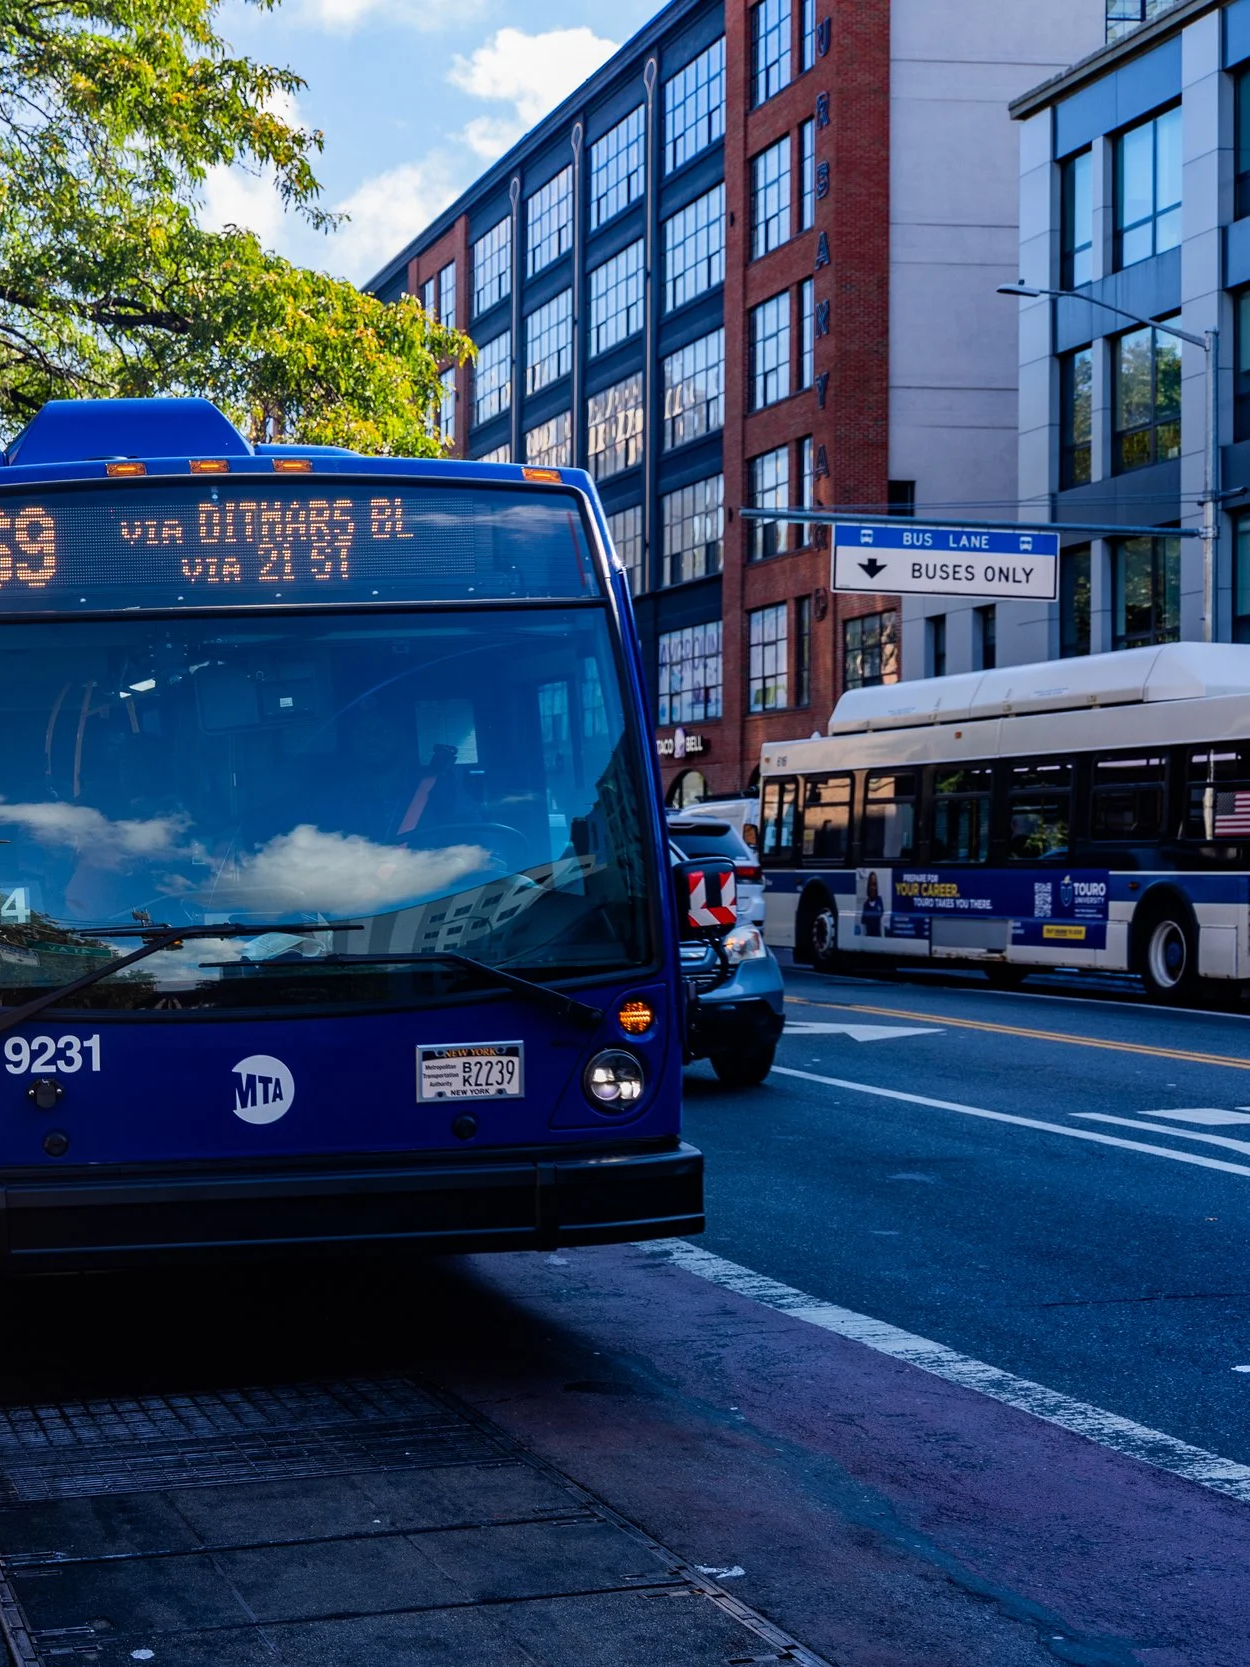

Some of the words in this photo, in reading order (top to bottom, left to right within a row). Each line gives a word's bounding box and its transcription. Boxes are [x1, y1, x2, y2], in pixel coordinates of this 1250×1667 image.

[120, 520, 183, 545] VIA
[199, 500, 354, 543] DITMARS
[370, 498, 414, 538] BL
[903, 532, 933, 546] BUS
[949, 534, 989, 549] LANE
[181, 557, 241, 583] VIA
[258, 543, 295, 580] 21
[311, 540, 352, 580] ST
[911, 562, 975, 581] BUSES
[983, 566, 1034, 584] ONLY
[656, 738, 674, 755] TACO
[686, 735, 703, 752] BELL
[895, 883, 919, 896] YOUR
[921, 883, 960, 897] CAREER.
[1073, 882, 1106, 896] TOURO
[913, 897, 934, 908] TOURO
[935, 898, 954, 908] TAKES
[956, 899, 969, 909] YOU
[4, 1034, 101, 1075] 9231
[445, 1048, 469, 1058] NEW
[471, 1047, 497, 1056] YORK
[235, 1072, 284, 1111] MTA
